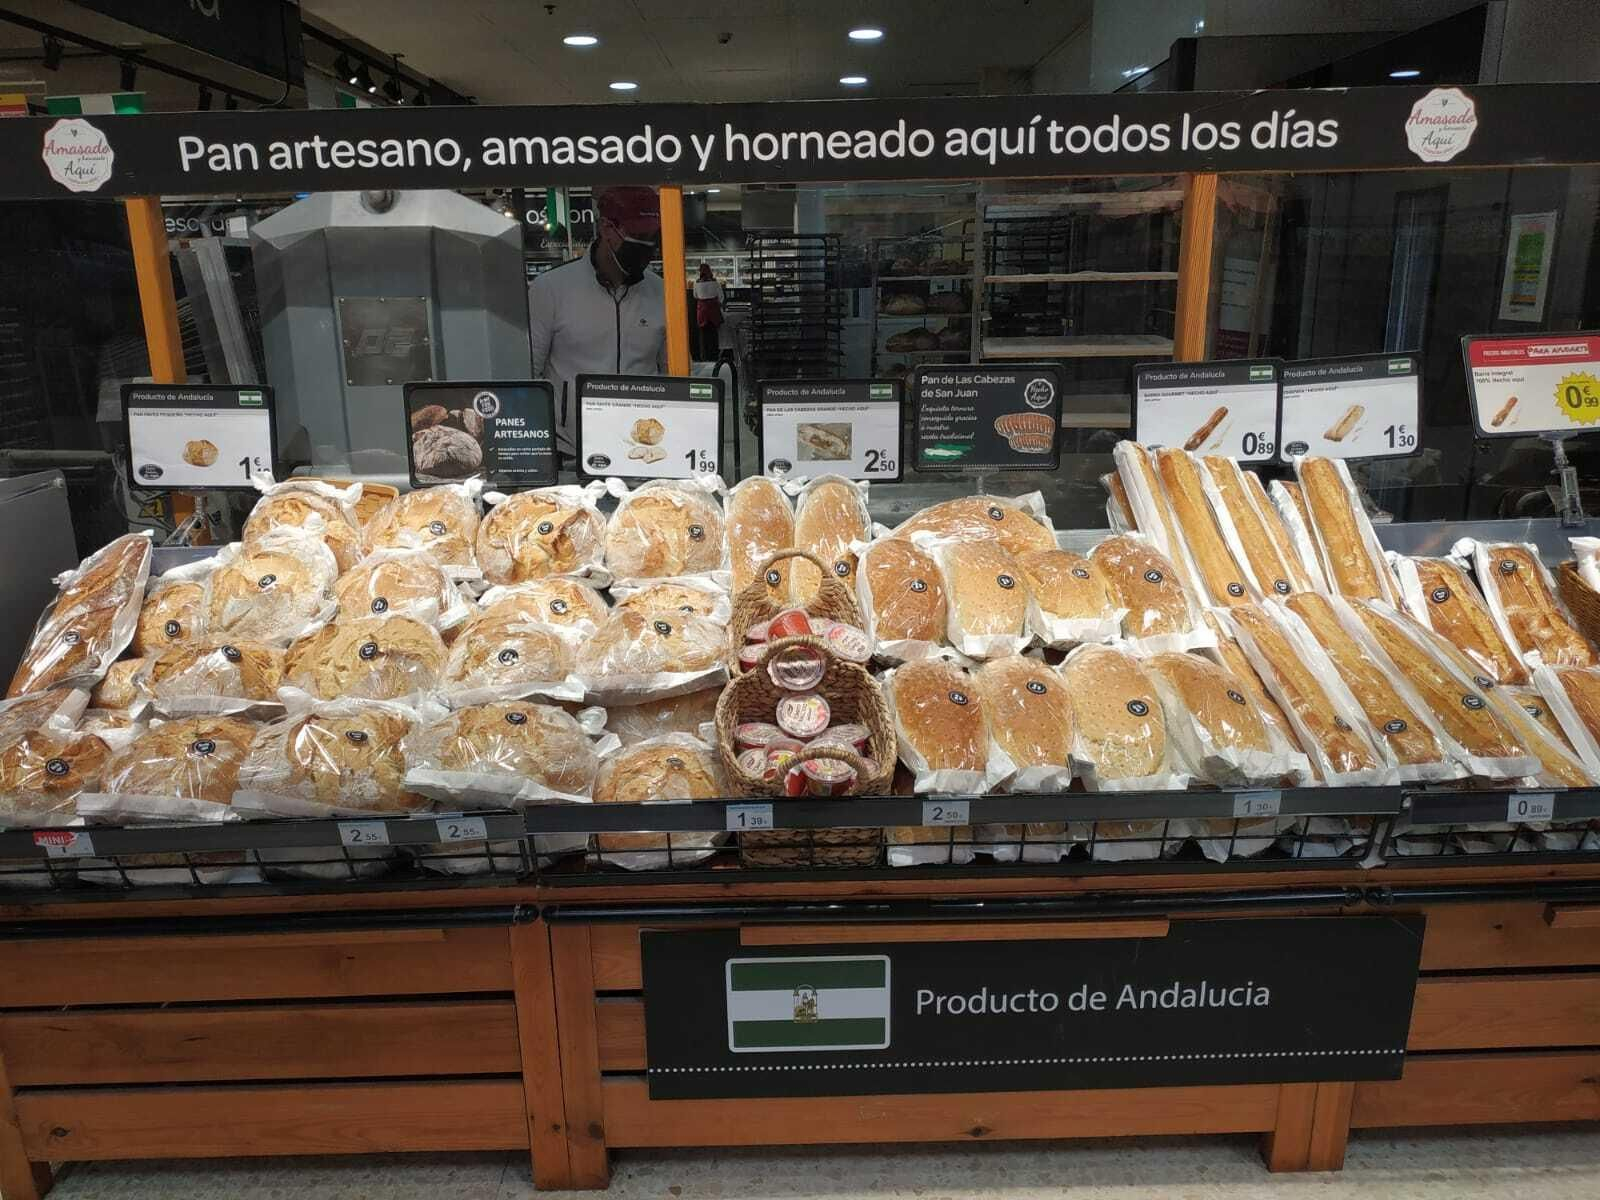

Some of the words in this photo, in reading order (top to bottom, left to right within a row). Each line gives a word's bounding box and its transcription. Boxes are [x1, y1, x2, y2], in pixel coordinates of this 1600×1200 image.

[1408, 107, 1475, 126] Amasado
[43, 138, 110, 157] Amasado
[178, 135, 259, 172] Pan
[268, 135, 472, 172] artesano,
[481, 124, 682, 166] amasado
[689, 133, 715, 171] y
[724, 118, 935, 161] horneado
[944, 114, 1042, 165] aquí
[1046, 113, 1171, 154] todos
[1181, 112, 1241, 151] los
[1250, 108, 1338, 150] días
[1421, 131, 1455, 149] Aquí
[64, 160, 96, 179] Aquí
[921, 375, 939, 385] Pan
[941, 375, 954, 385] de
[956, 375, 972, 385] Las
[973, 375, 1016, 385] Cabezas
[1145, 373, 1177, 381] Producto
[1283, 369, 1317, 377] Producto
[1318, 368, 1327, 376] de
[587, 382, 619, 391] Producto
[620, 383, 629, 391] de
[767, 388, 798, 397] Producto
[800, 388, 809, 396] de
[921, 389, 934, 398] de
[935, 388, 953, 398] San
[955, 388, 978, 398] Juan
[132, 393, 167, 401] Producto
[167, 393, 176, 401] de
[1565, 385, 1582, 409] 0
[495, 418, 526, 426] PANES
[494, 430, 550, 439] ARTESANOS
[1384, 425, 1395, 448] 1
[1399, 435, 1415, 447] 30
[1242, 432, 1258, 456] 0
[1258, 443, 1274, 454] 89
[685, 449, 696, 470] 1
[699, 460, 715, 473] 99
[864, 449, 879, 473] 2
[880, 461, 895, 472] 50
[932, 807, 943, 820] 2
[1518, 800, 1528, 815] 0
[737, 812, 746, 827] 1
[350, 829, 362, 842] 2
[448, 825, 460, 838] 2
[916, 987, 1059, 1015] Producto
[1068, 984, 1107, 1012] de
